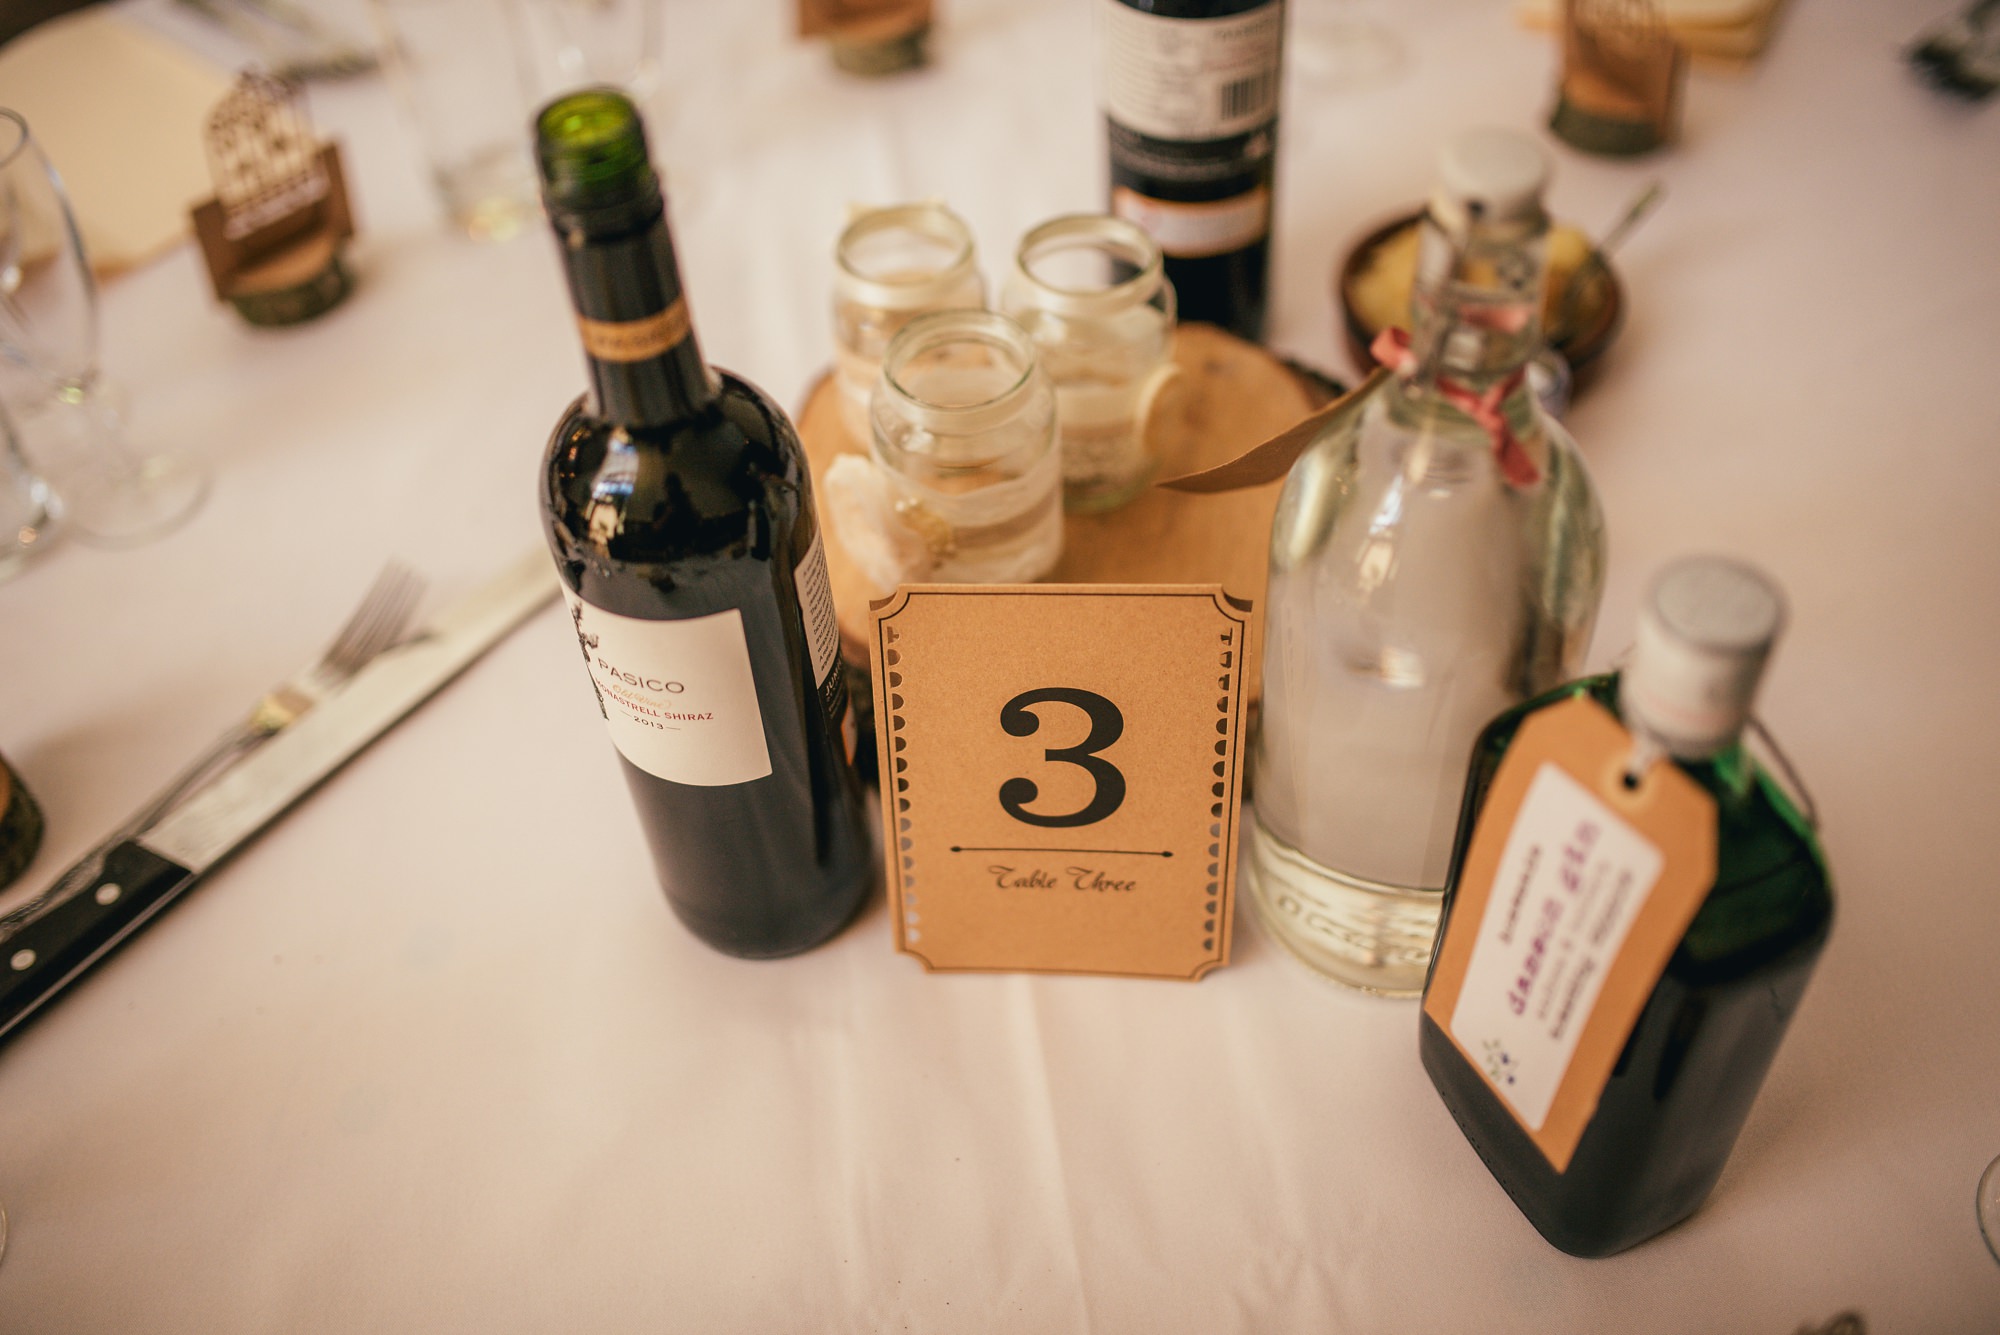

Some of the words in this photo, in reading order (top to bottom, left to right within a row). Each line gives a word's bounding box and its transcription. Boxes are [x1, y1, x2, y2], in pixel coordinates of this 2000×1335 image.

[598, 657, 685, 694] PASICO
[634, 715, 665, 730] 2013
[664, 712, 714, 721] SHIRAZ
[999, 687, 1126, 828] 3
[988, 865, 1057, 889] Table
[1066, 866, 1136, 892] Three
